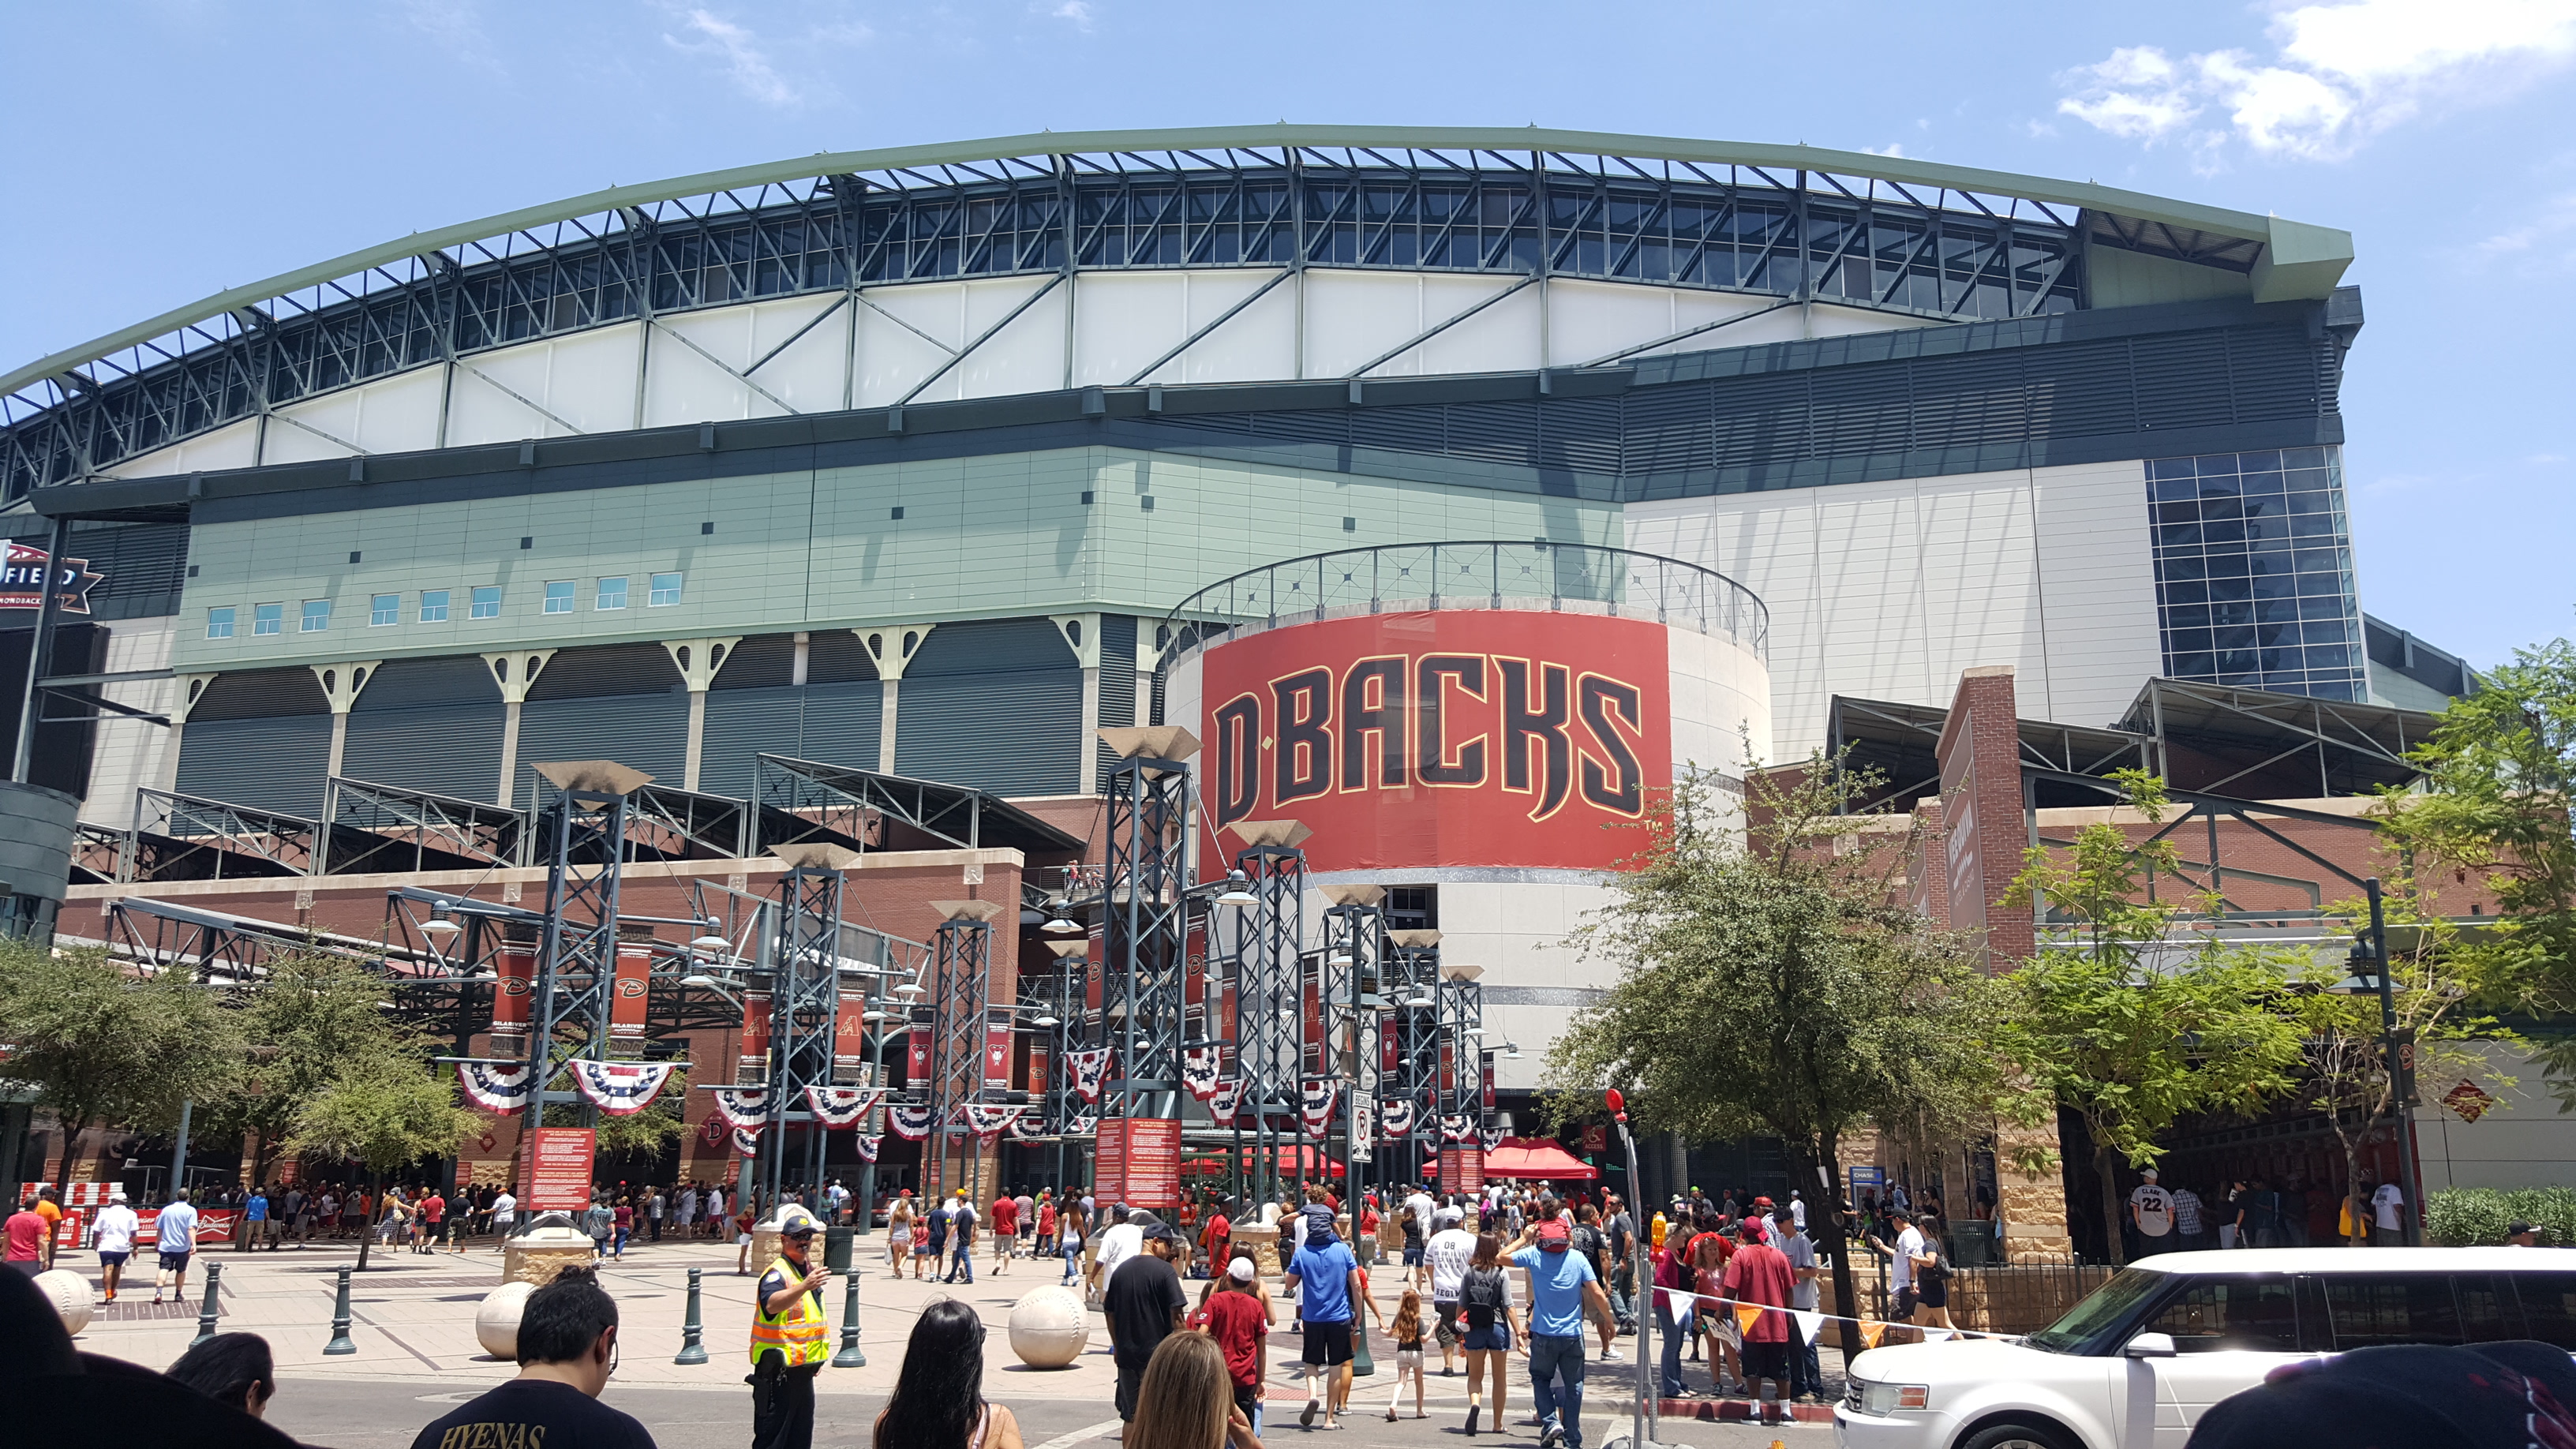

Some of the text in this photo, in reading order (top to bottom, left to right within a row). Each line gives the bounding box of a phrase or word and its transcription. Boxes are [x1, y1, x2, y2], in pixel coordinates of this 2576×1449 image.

[5, 567, 77, 585] FIED
[1643, 820, 1663, 833] TM
[1355, 1094, 1369, 1106] BEGINS
[708, 1121, 723, 1140] D
[2142, 1197, 2162, 1212] 22
[440, 1423, 546, 1449] HYENAS
